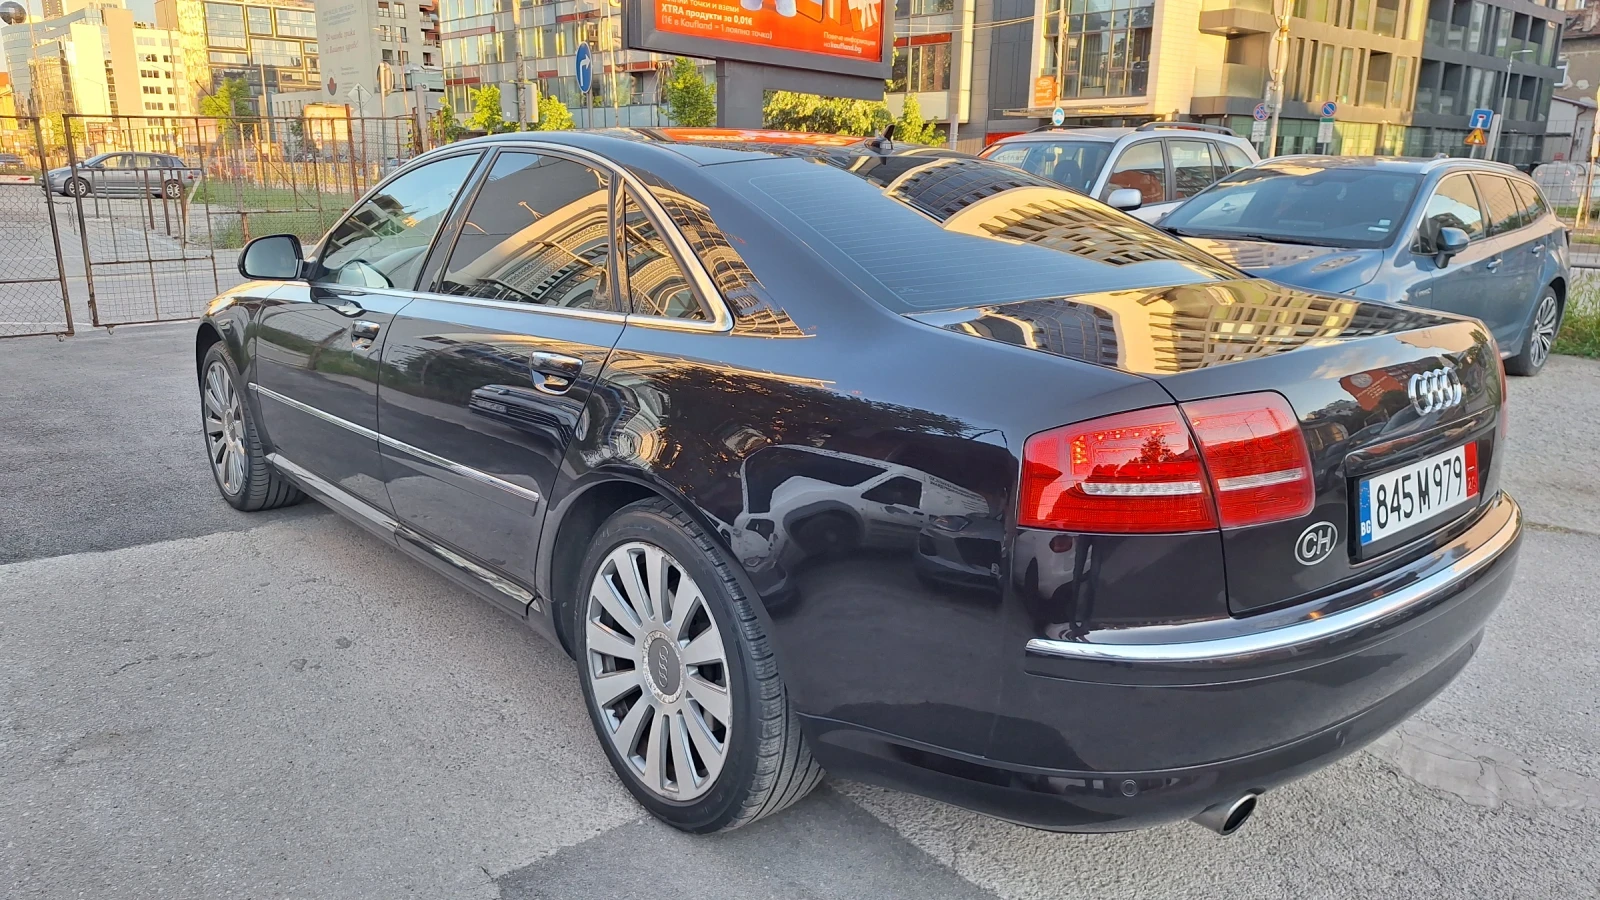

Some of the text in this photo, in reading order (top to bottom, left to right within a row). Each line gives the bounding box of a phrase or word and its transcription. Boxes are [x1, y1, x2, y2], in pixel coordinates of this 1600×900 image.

[661, 3, 684, 15] XTRA
[686, 9, 722, 21] продукти
[733, 15, 753, 26] 0,01€
[718, 4, 740, 13] вземи
[680, 17, 713, 30] Kaufland
[751, 30, 773, 40] точка)
[830, 41, 862, 53] kaufland.bg
[1360, 519, 1372, 536] BG
[1302, 526, 1332, 559] CH
